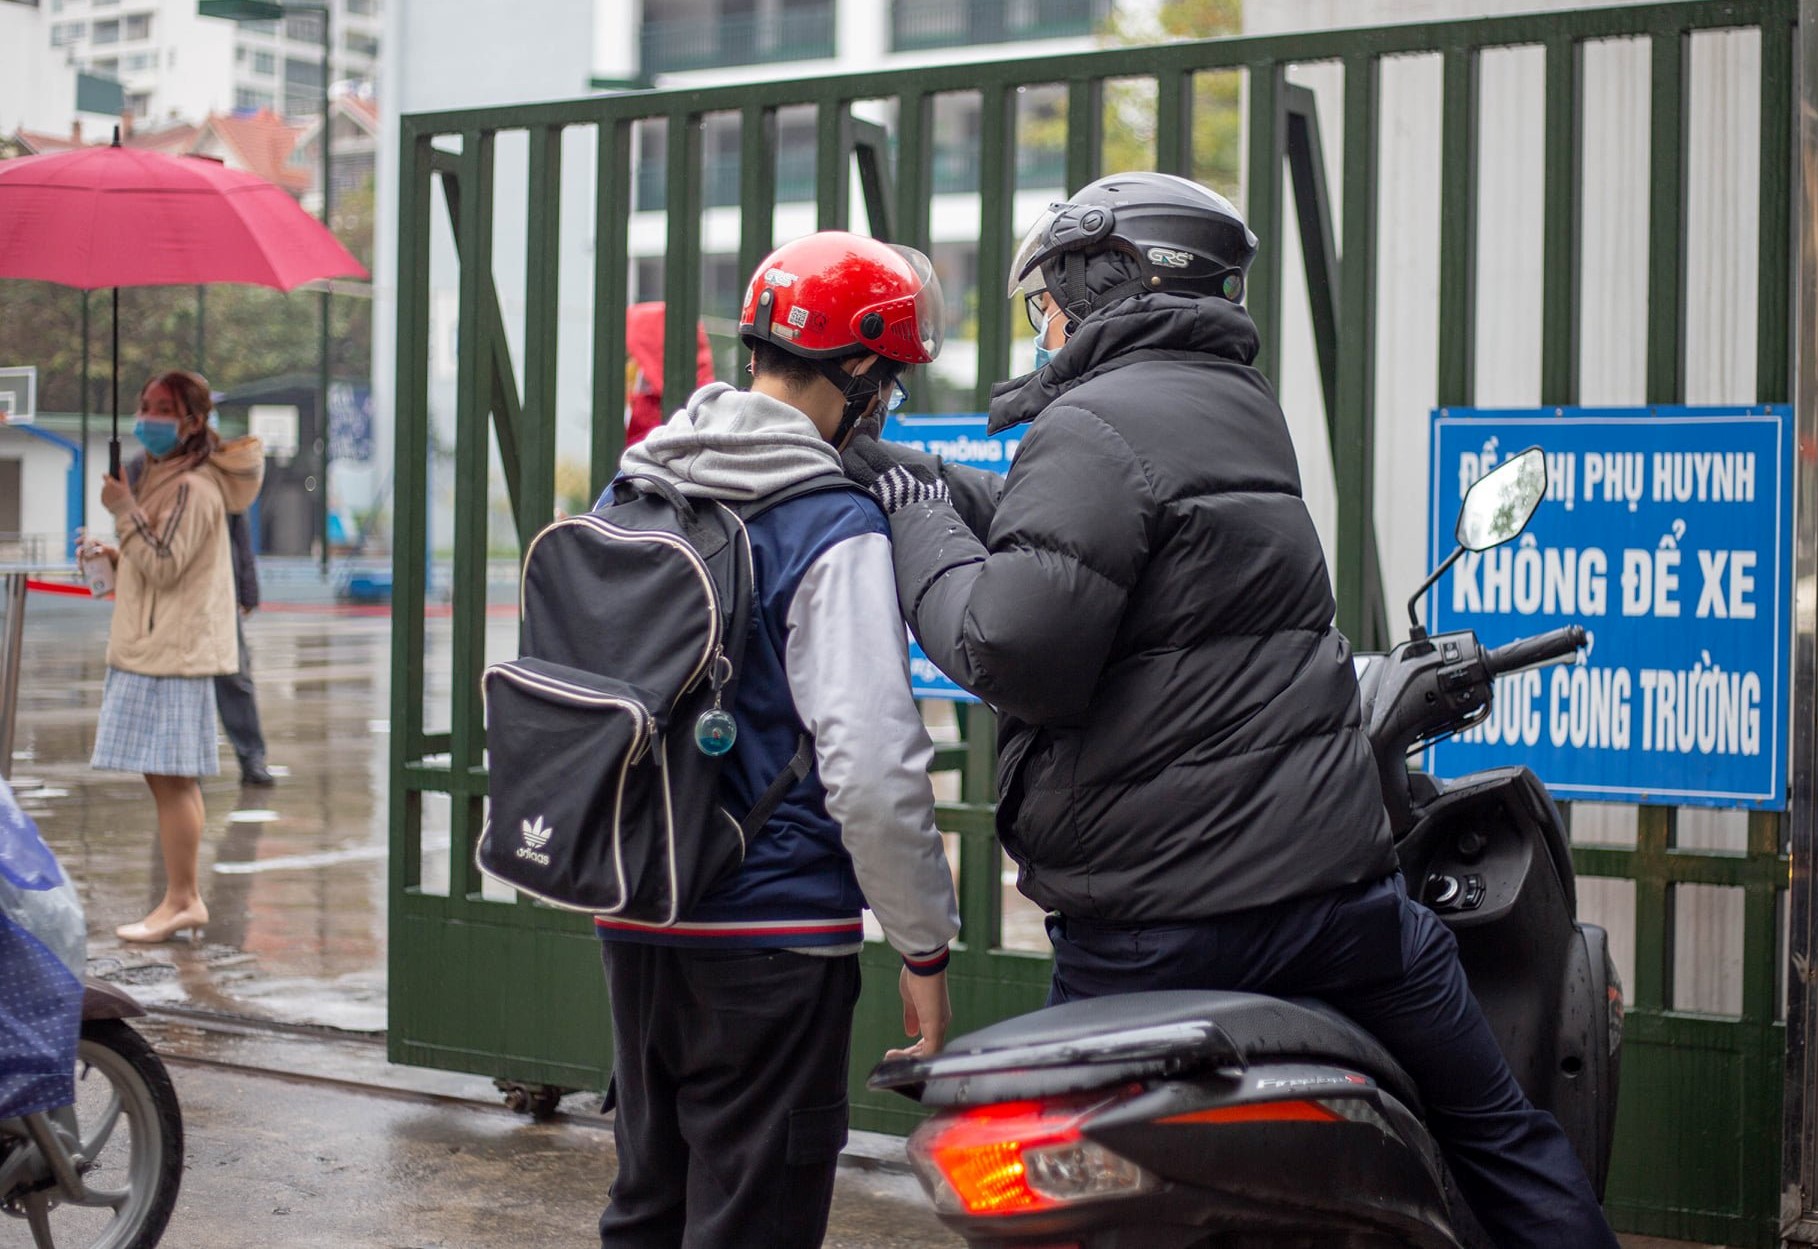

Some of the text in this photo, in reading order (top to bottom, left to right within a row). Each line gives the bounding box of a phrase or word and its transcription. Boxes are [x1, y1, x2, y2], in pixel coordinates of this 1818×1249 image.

[1583, 452, 1645, 512] PHỤ
[1653, 452, 1756, 502] HUYNH
[1452, 518, 1758, 619] KHÔNG ĐỂ XE
[1549, 631, 1631, 751] CỔNG
[1639, 649, 1761, 756] TRƯỜNG
[516, 847, 550, 866] adidas
